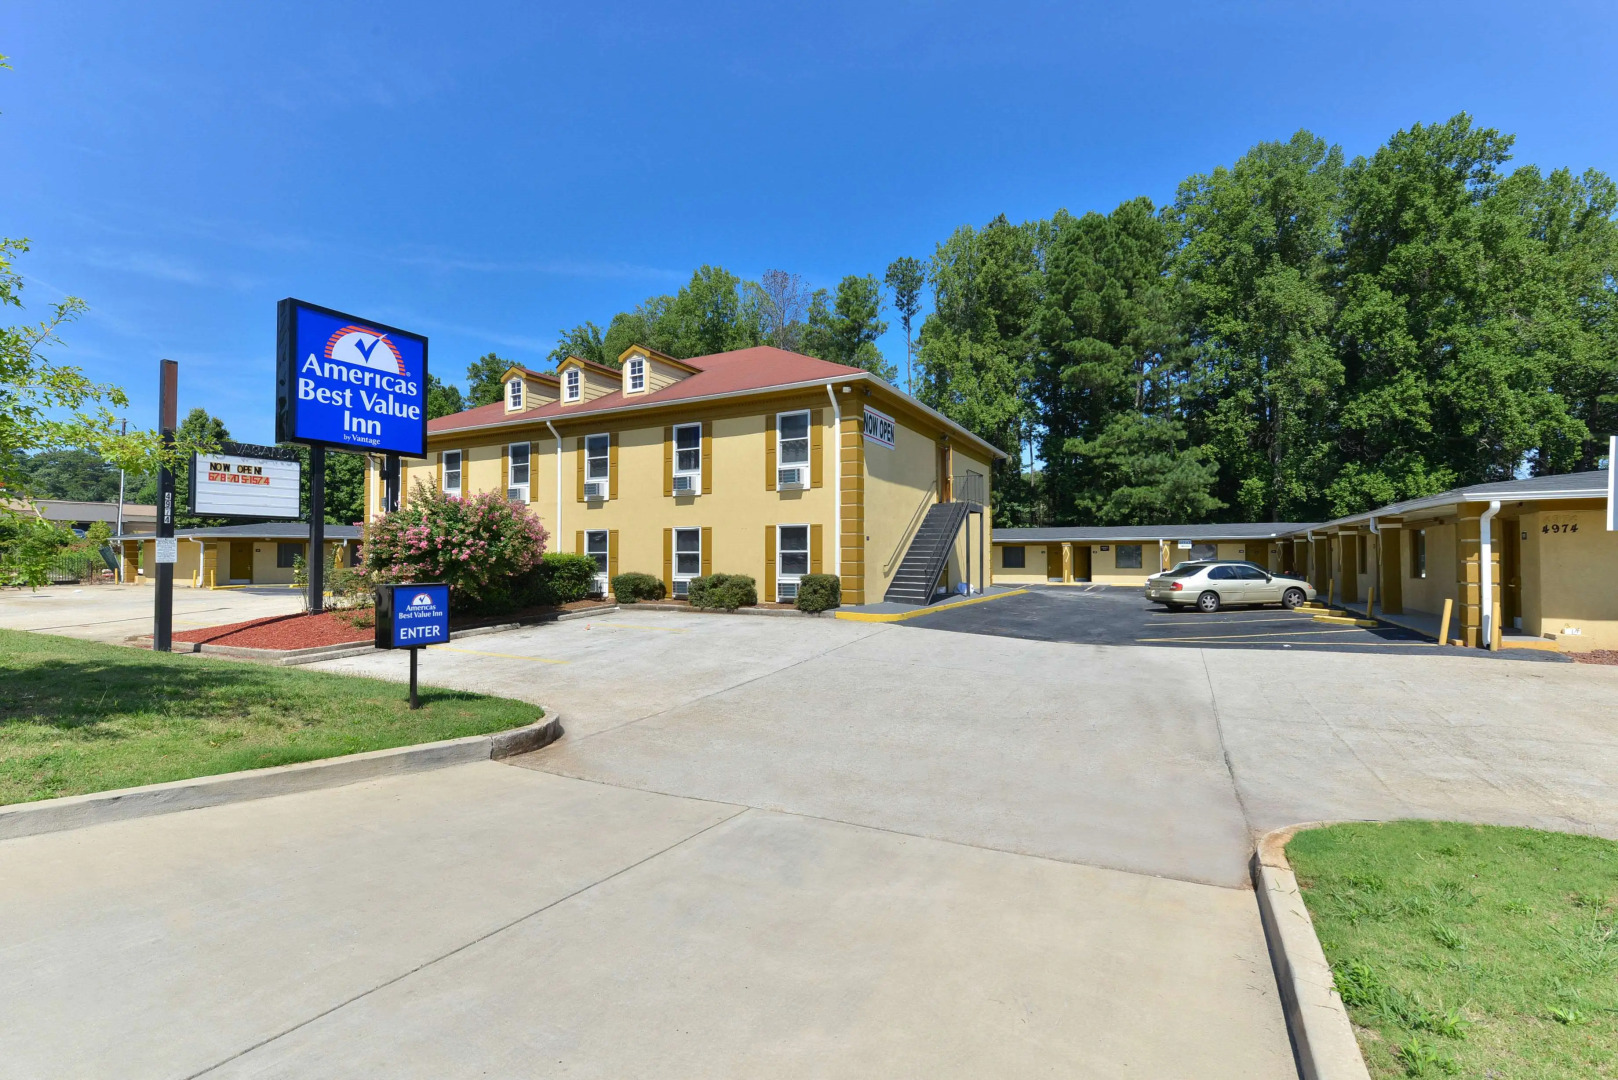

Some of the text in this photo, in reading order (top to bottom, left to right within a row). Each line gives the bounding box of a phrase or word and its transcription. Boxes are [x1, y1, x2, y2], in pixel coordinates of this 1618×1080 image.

[302, 353, 417, 396] Americas
[298, 377, 420, 420] Best Value
[344, 410, 381, 436] Inn
[863, 411, 895, 444] NOW OPEN
[351, 434, 381, 446] Vantage
[232, 443, 298, 459] VACANCY
[210, 462, 230, 472] NOW
[164, 492, 172, 523] 4974
[1542, 523, 1579, 534] 4974
[400, 625, 440, 639] ENTER
